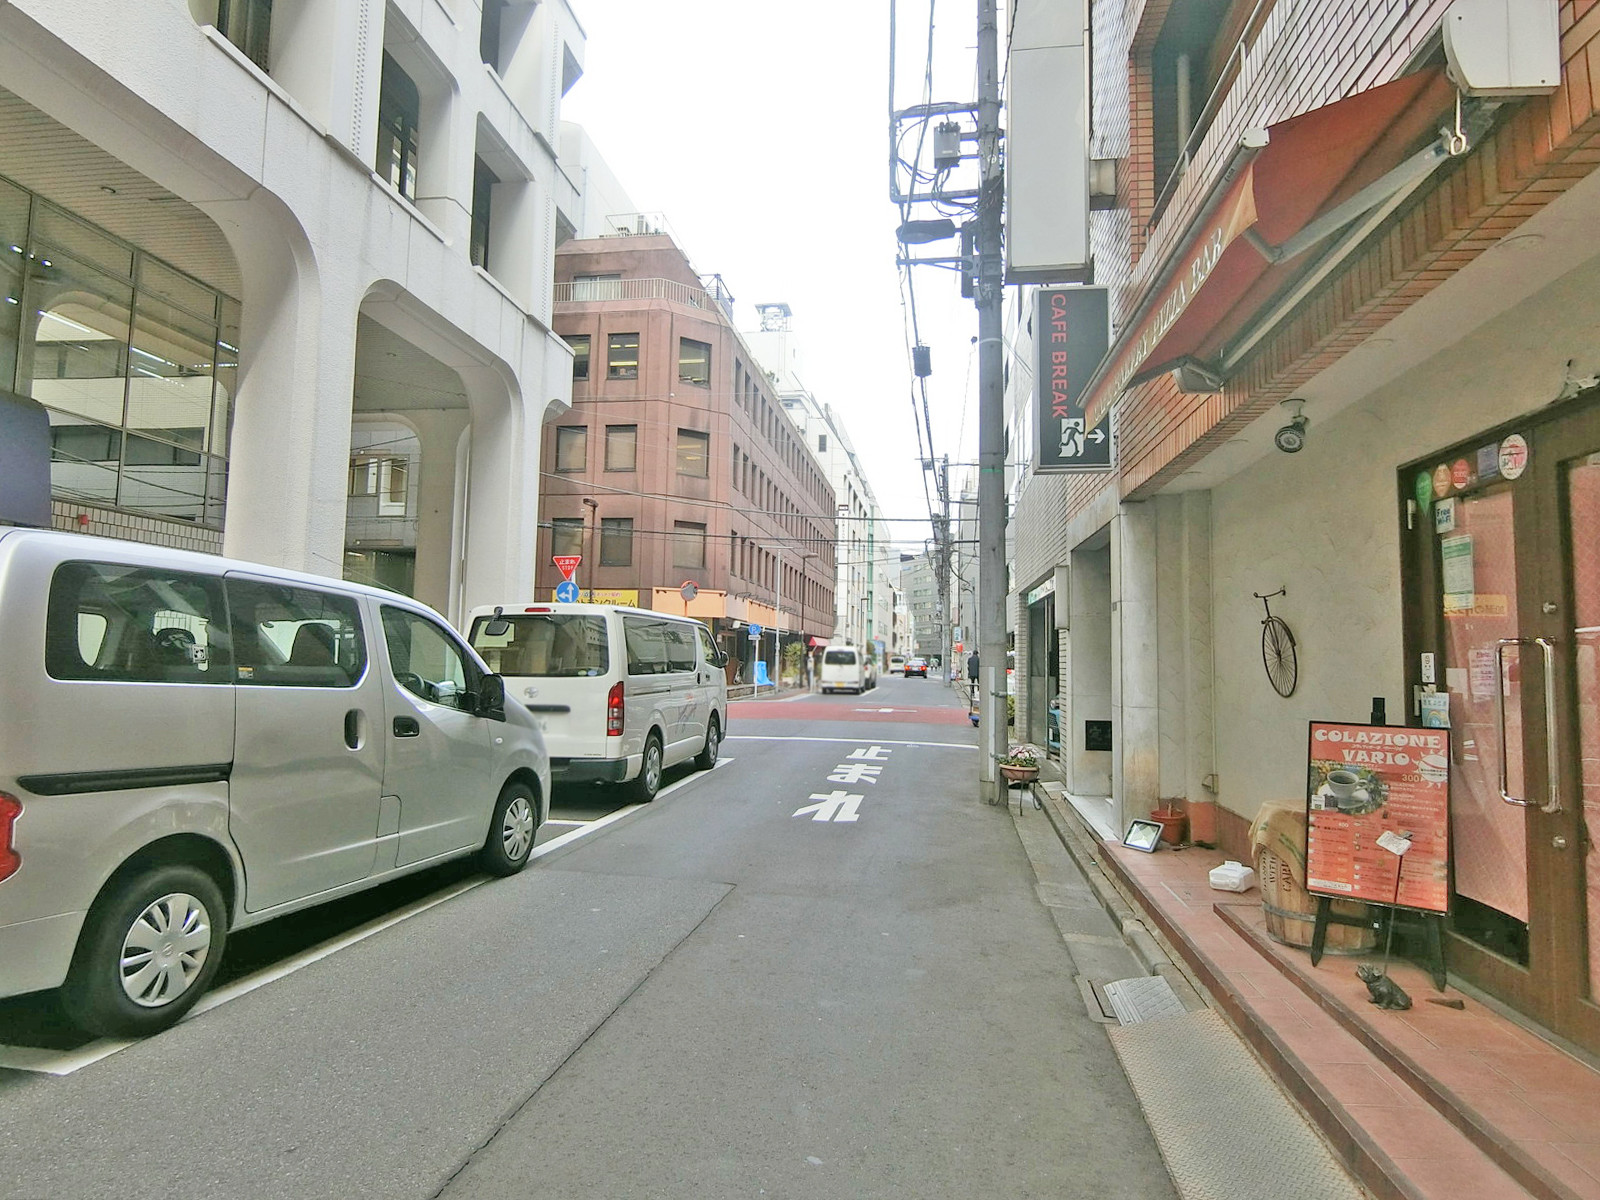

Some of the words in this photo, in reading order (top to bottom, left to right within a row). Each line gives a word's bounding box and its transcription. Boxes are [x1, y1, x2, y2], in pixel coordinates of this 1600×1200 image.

[1152, 281, 1186, 345] PIZZA
[1190, 227, 1223, 294] BAR
[1051, 293, 1067, 344] CAFE
[1051, 351, 1068, 419] BREAK
[1314, 729, 1441, 749] COLAZIONE
[1341, 749, 1410, 766] VARIO
[792, 746, 892, 823] 止まれ
[1402, 773, 1419, 783] 300
